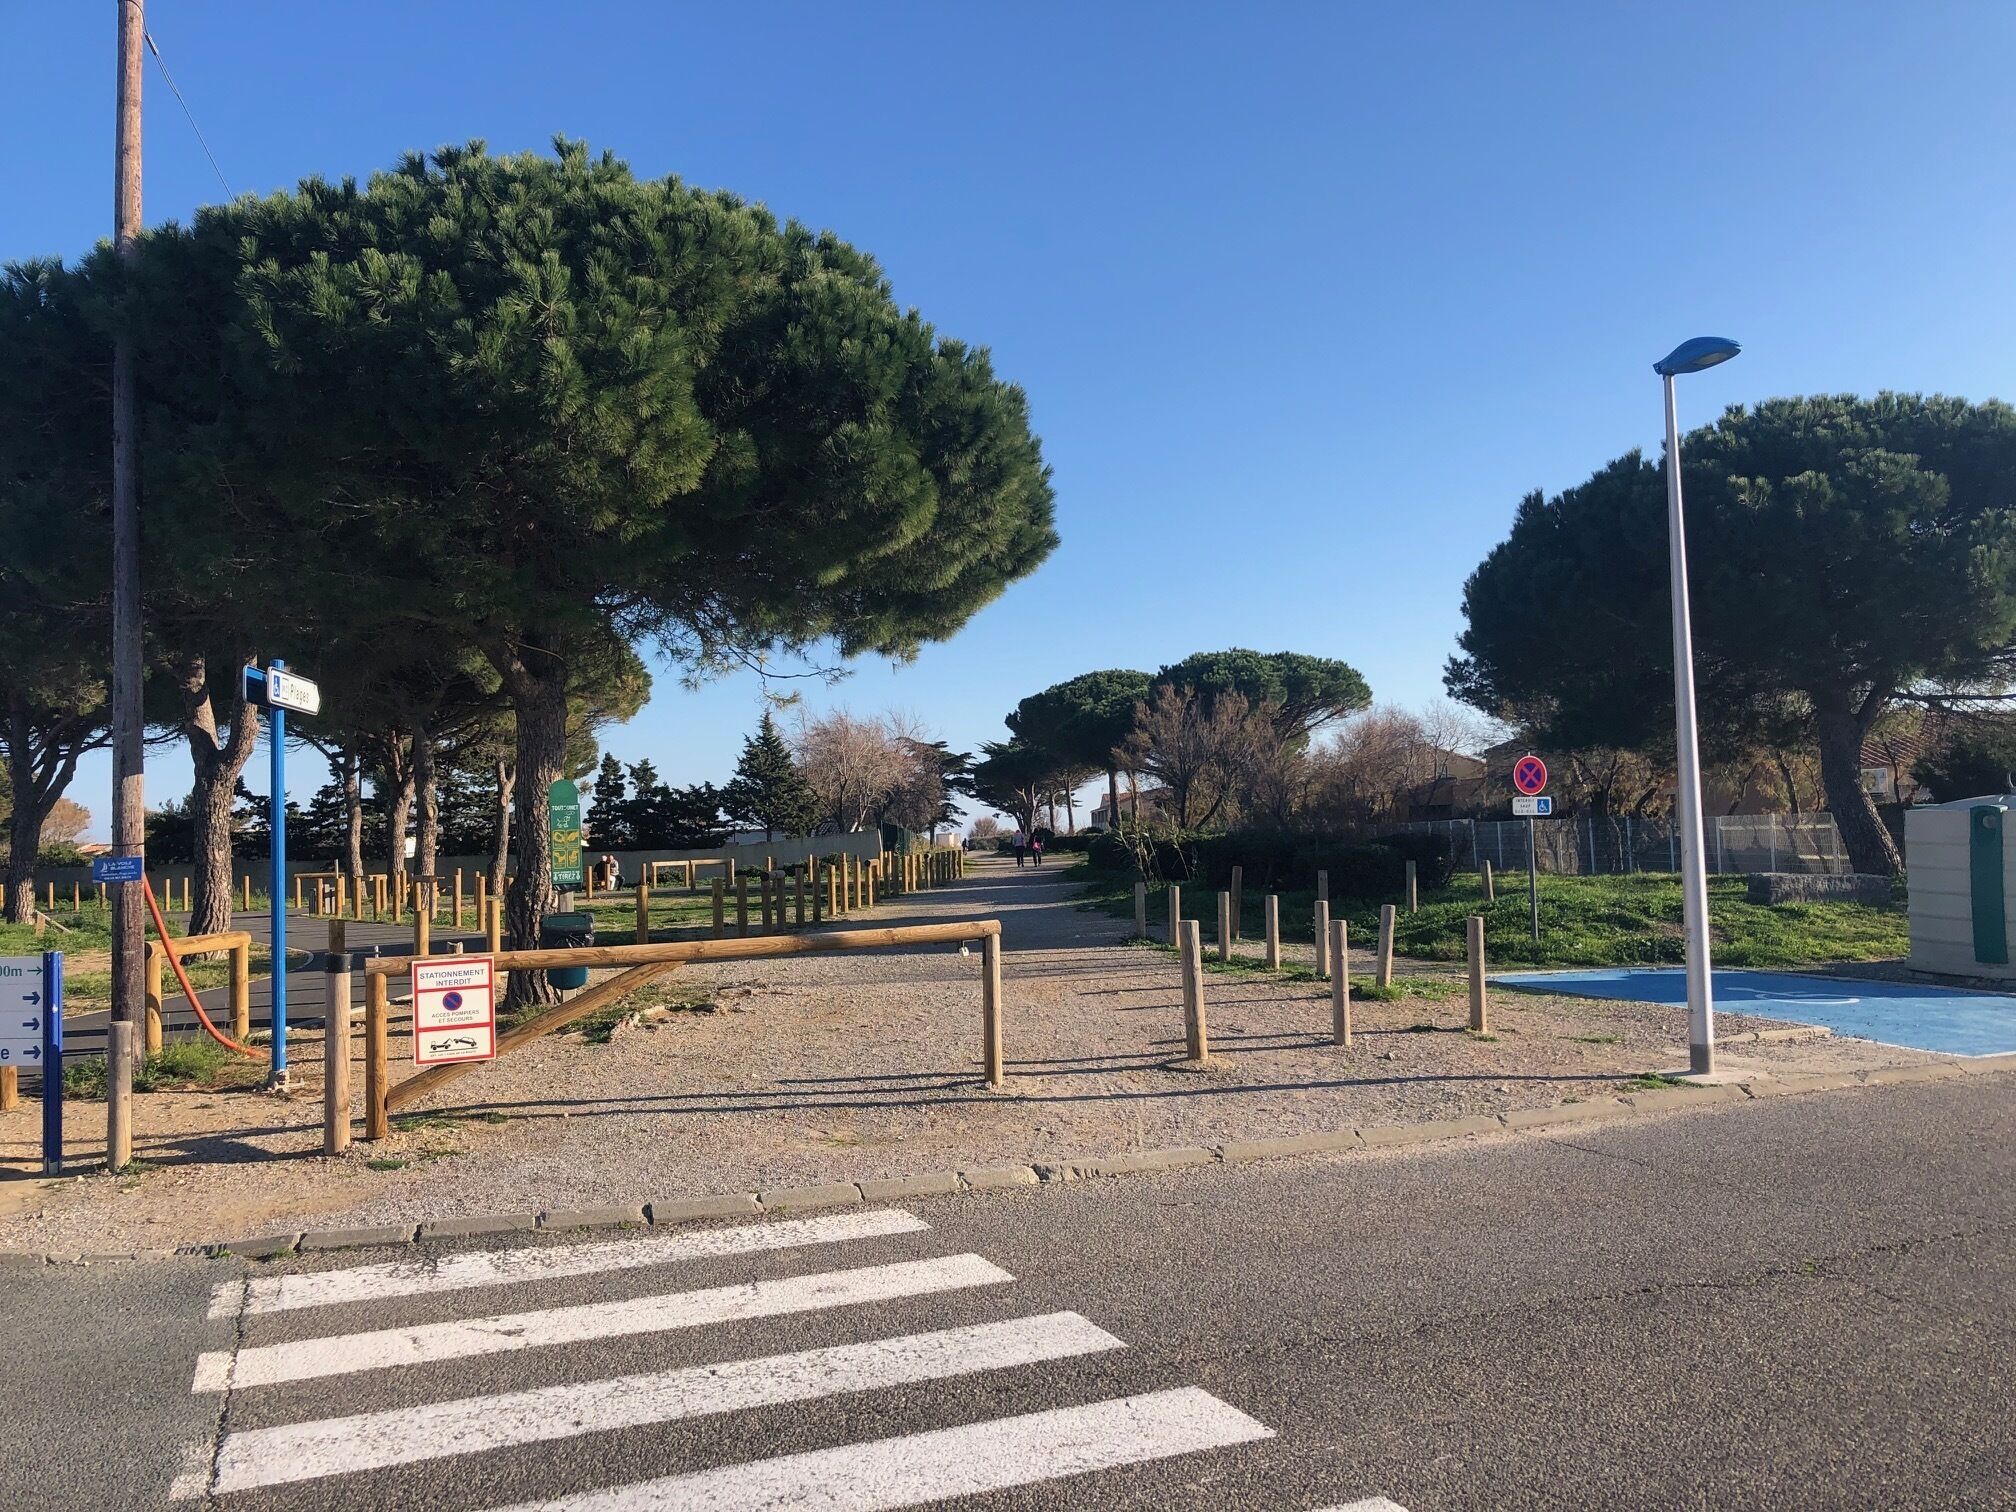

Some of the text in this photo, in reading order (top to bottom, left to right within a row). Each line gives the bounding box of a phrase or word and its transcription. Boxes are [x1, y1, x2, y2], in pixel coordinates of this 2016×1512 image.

[419, 968, 485, 979] STATIONNEMENT
[435, 977, 472, 987] INTERDIT
[451, 1009, 480, 1017] POMPIERS
